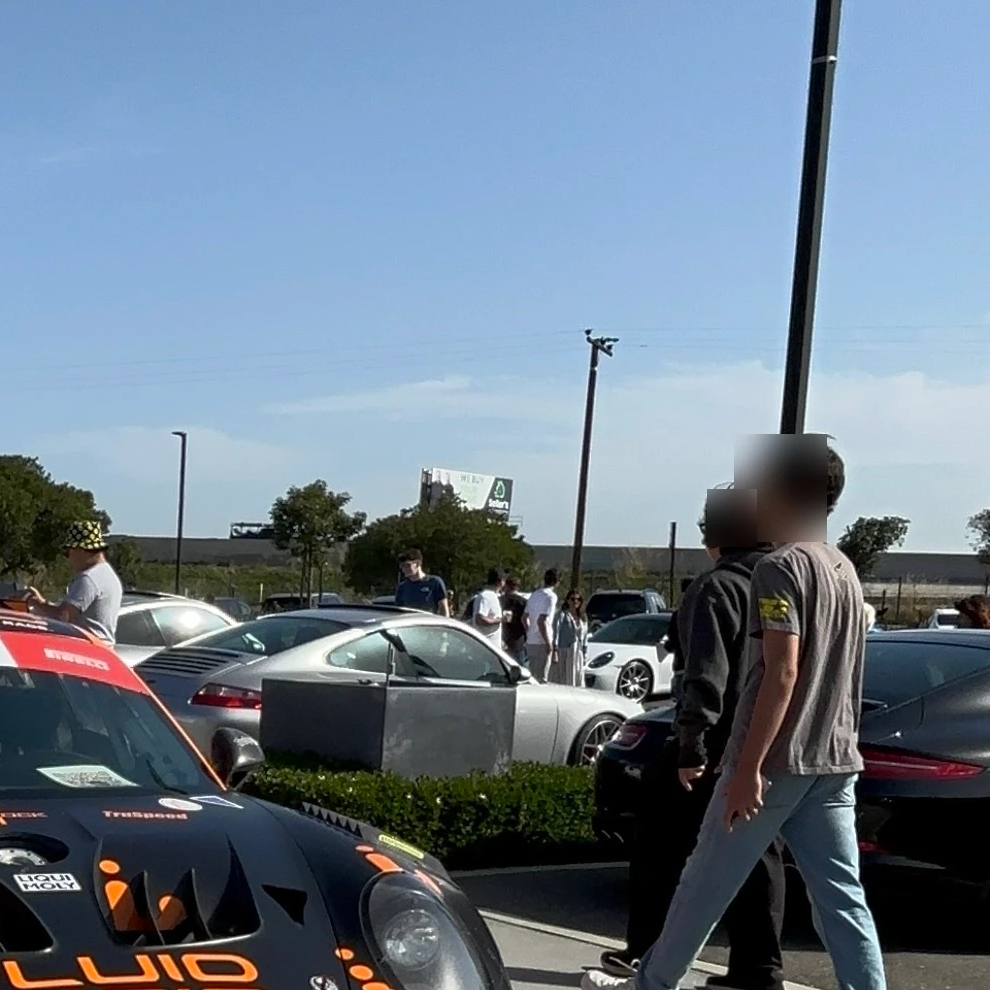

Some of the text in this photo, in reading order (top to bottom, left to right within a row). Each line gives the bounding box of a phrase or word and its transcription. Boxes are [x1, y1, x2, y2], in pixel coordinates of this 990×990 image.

[43, 648, 110, 671] PIRELLI
[17, 874, 72, 882] LIQUI
[22, 882, 75, 890] MOLY
